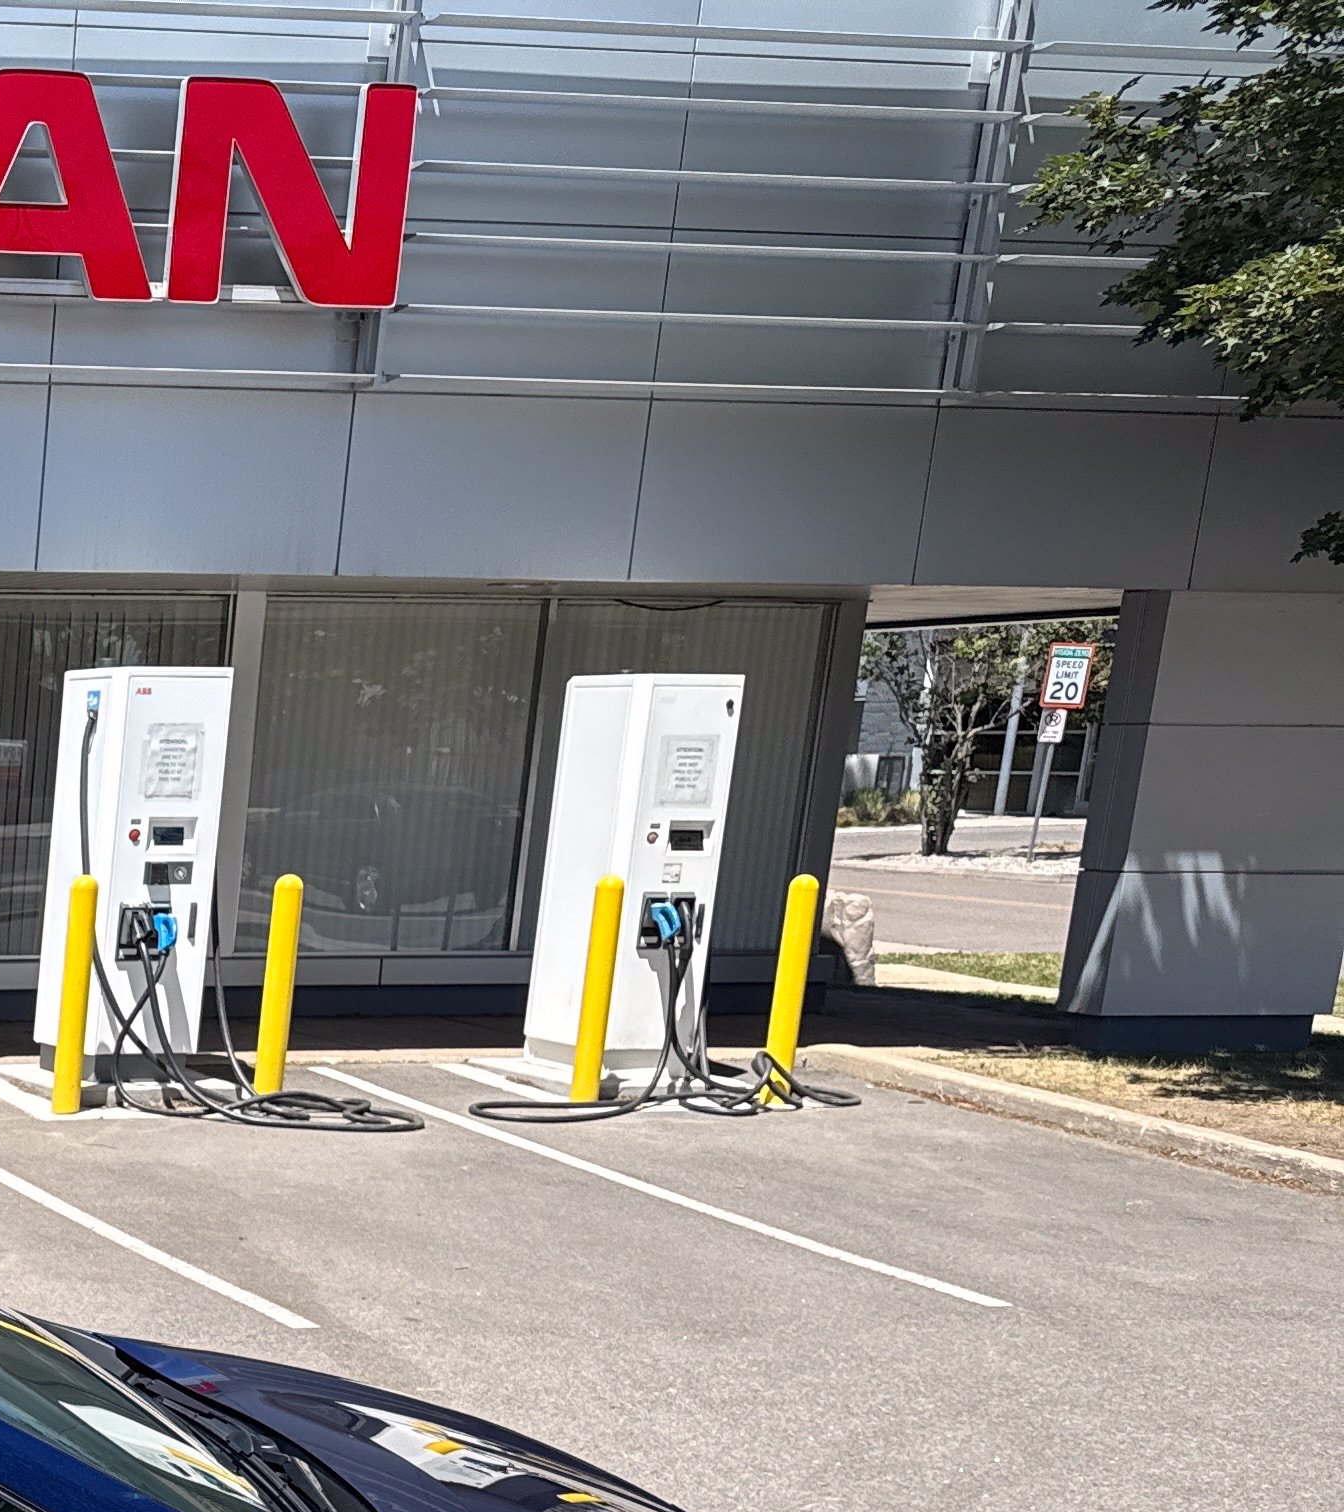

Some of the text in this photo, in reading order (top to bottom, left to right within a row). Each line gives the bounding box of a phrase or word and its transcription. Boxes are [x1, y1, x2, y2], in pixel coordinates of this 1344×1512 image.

[1055, 660, 1084, 669] SPEED
[1055, 670, 1079, 679] LIMIT
[1049, 681, 1079, 701] 20
